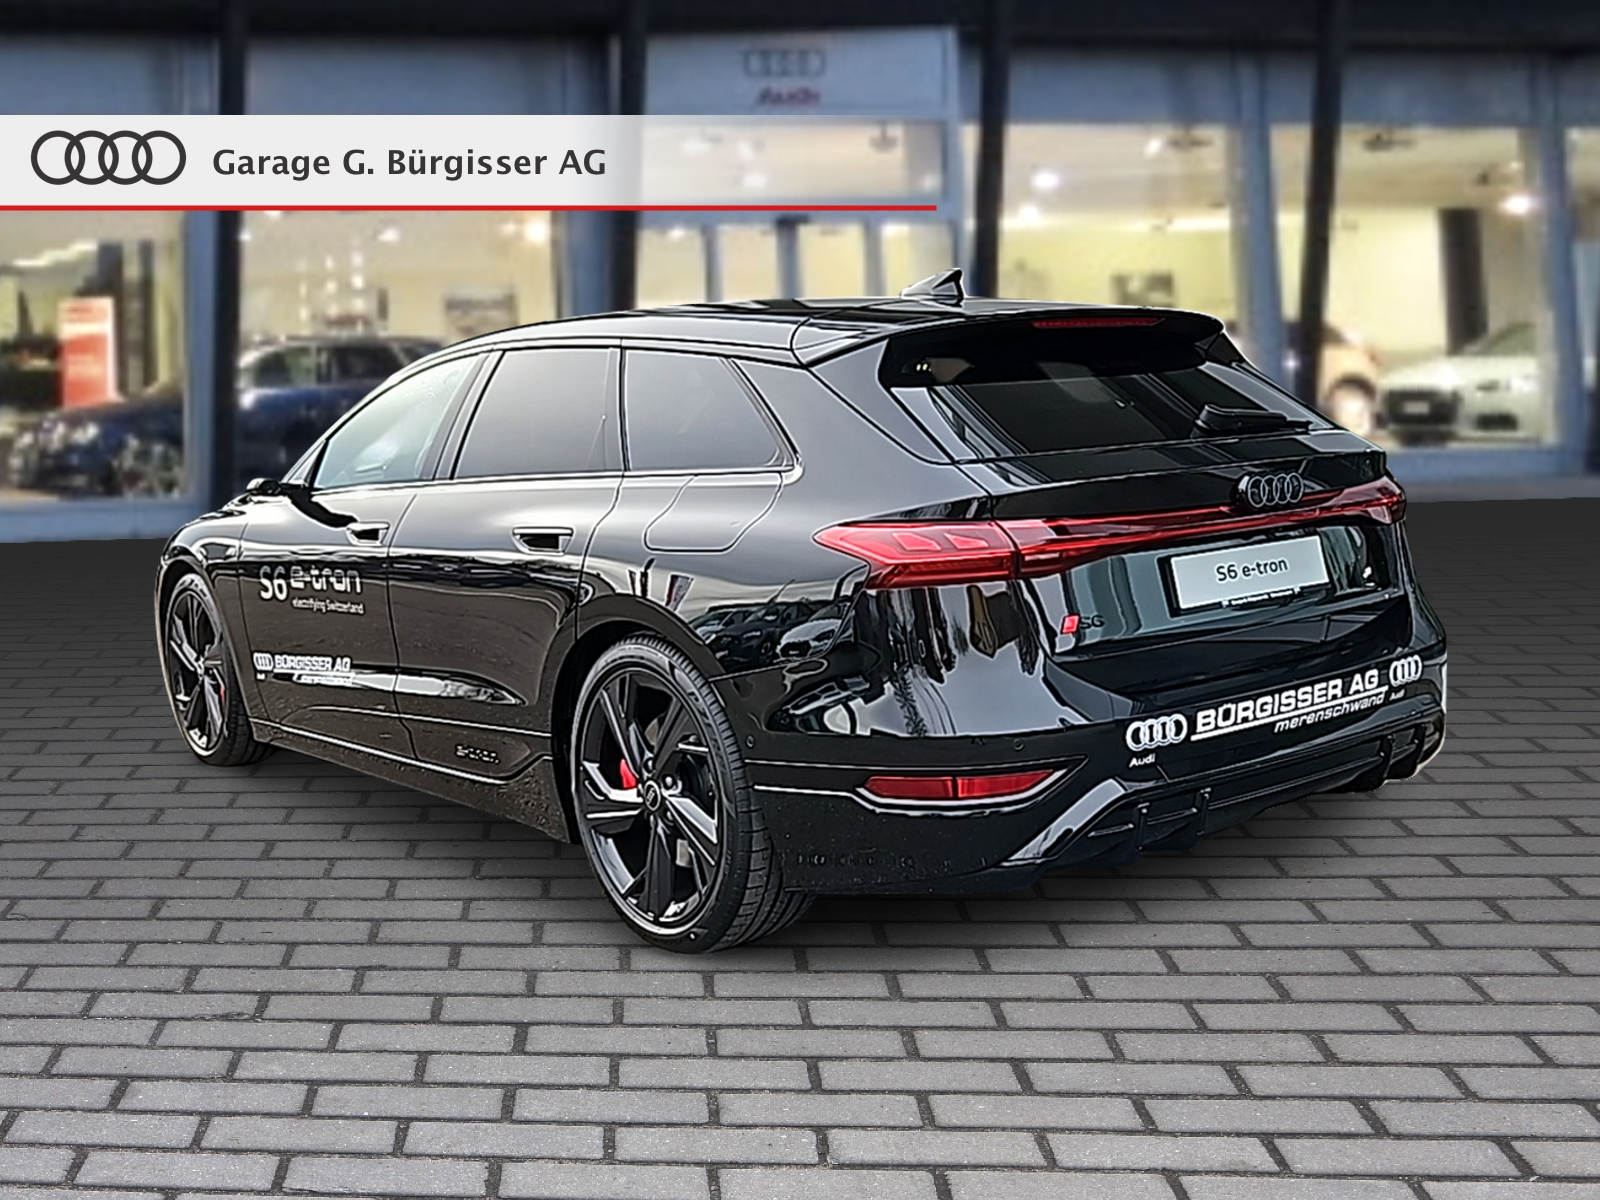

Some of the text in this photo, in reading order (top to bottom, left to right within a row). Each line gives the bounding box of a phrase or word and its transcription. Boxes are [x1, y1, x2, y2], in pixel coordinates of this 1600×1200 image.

[259, 565, 361, 601] S6 e-tron
[1216, 558, 1288, 582] S6 e-tron
[333, 657, 351, 672] AG
[1196, 668, 1379, 733] BÜRGISSER AG
[1273, 690, 1386, 733] merenschwand
[1128, 753, 1156, 768] Audi
